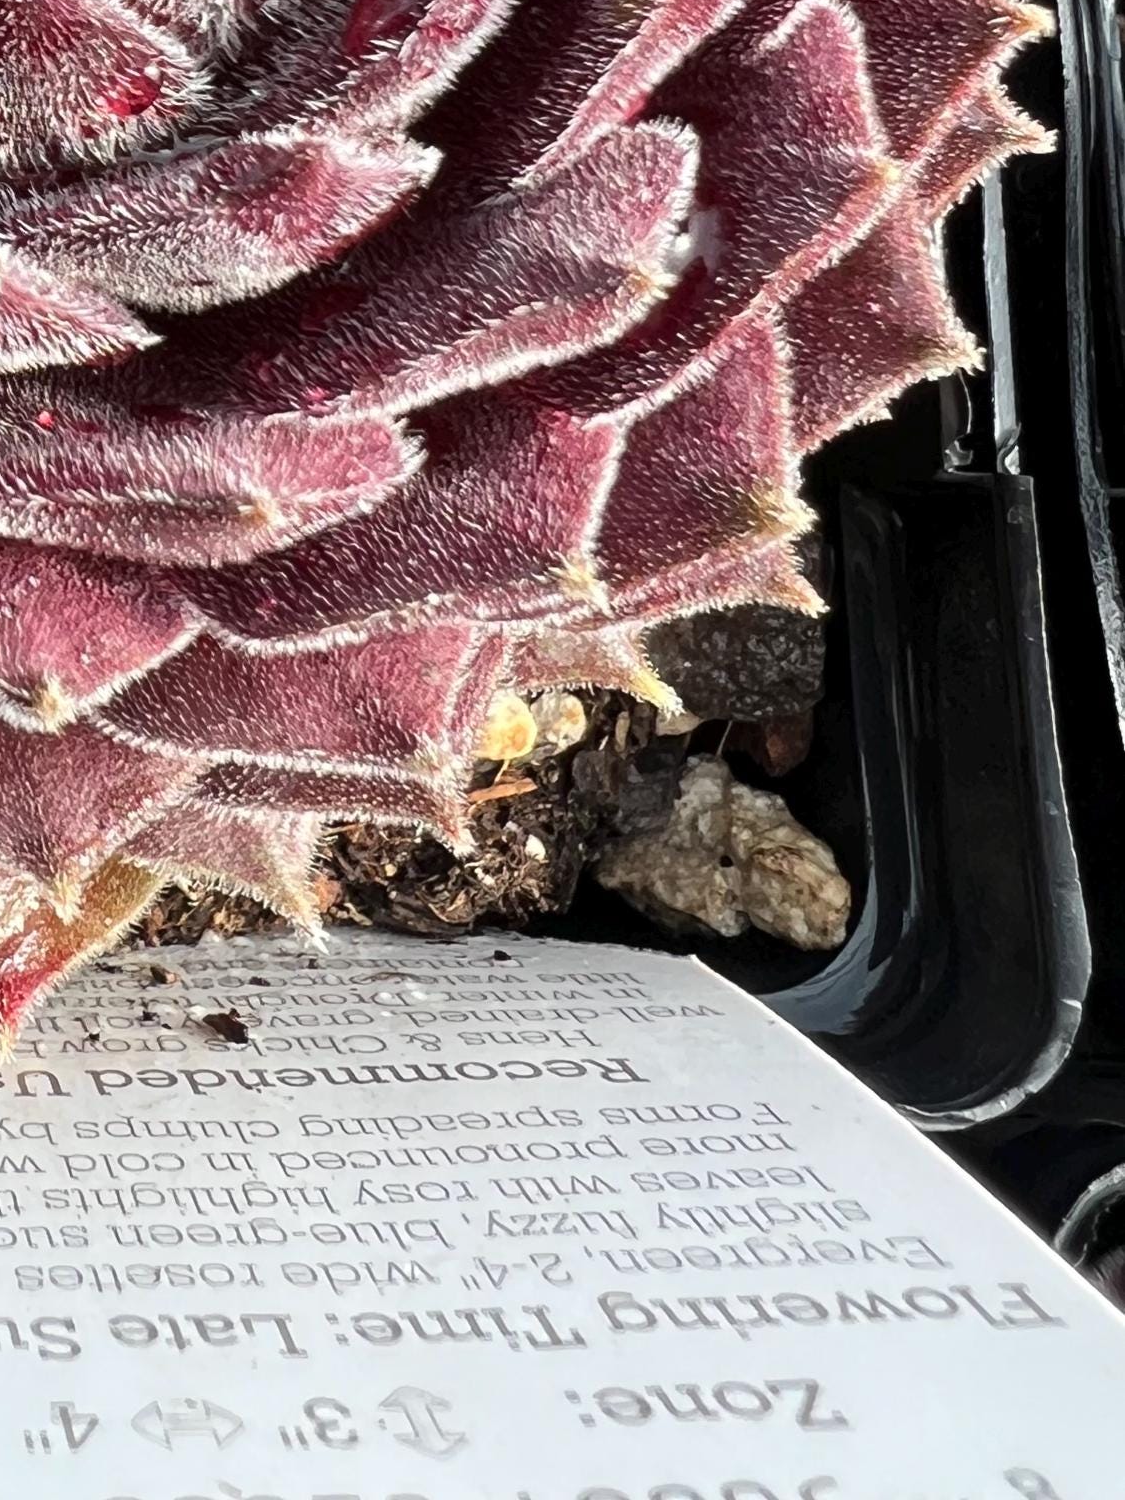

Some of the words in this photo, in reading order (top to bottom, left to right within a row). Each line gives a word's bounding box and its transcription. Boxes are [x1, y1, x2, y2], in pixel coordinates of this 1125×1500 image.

[603, 988, 651, 1002] in
[390, 1005, 725, 1027] well-drained,
[59, 1034, 187, 1053] grow
[400, 1032, 441, 1052] &
[457, 1029, 601, 1048] Hens
[85, 1058, 650, 1097] Recommended
[71, 1115, 280, 1146] clumps
[298, 1105, 584, 1140] spreading
[598, 1101, 791, 1129] Forms
[269, 1134, 629, 1180] pronounced
[641, 1132, 797, 1158] more
[57, 1152, 186, 1180] cold
[203, 1152, 258, 1180] in
[629, 1165, 837, 1197] leaves
[42, 1181, 333, 1217] highlights
[351, 1178, 478, 1207] rosy
[491, 1175, 621, 1204] with
[106, 1217, 456, 1253] blue-green
[461, 1207, 637, 1243] fuzzy,
[654, 1197, 871, 1242] slightly
[582, 1233, 953, 1277] Evergreen,
[13, 1262, 263, 1299] rosettes
[280, 1259, 439, 1300] wide
[324, 1303, 589, 1354] Time:
[595, 1281, 1068, 1342] Flowering
[107, 1310, 308, 1361] Late
[563, 1377, 853, 1434] Zone:
